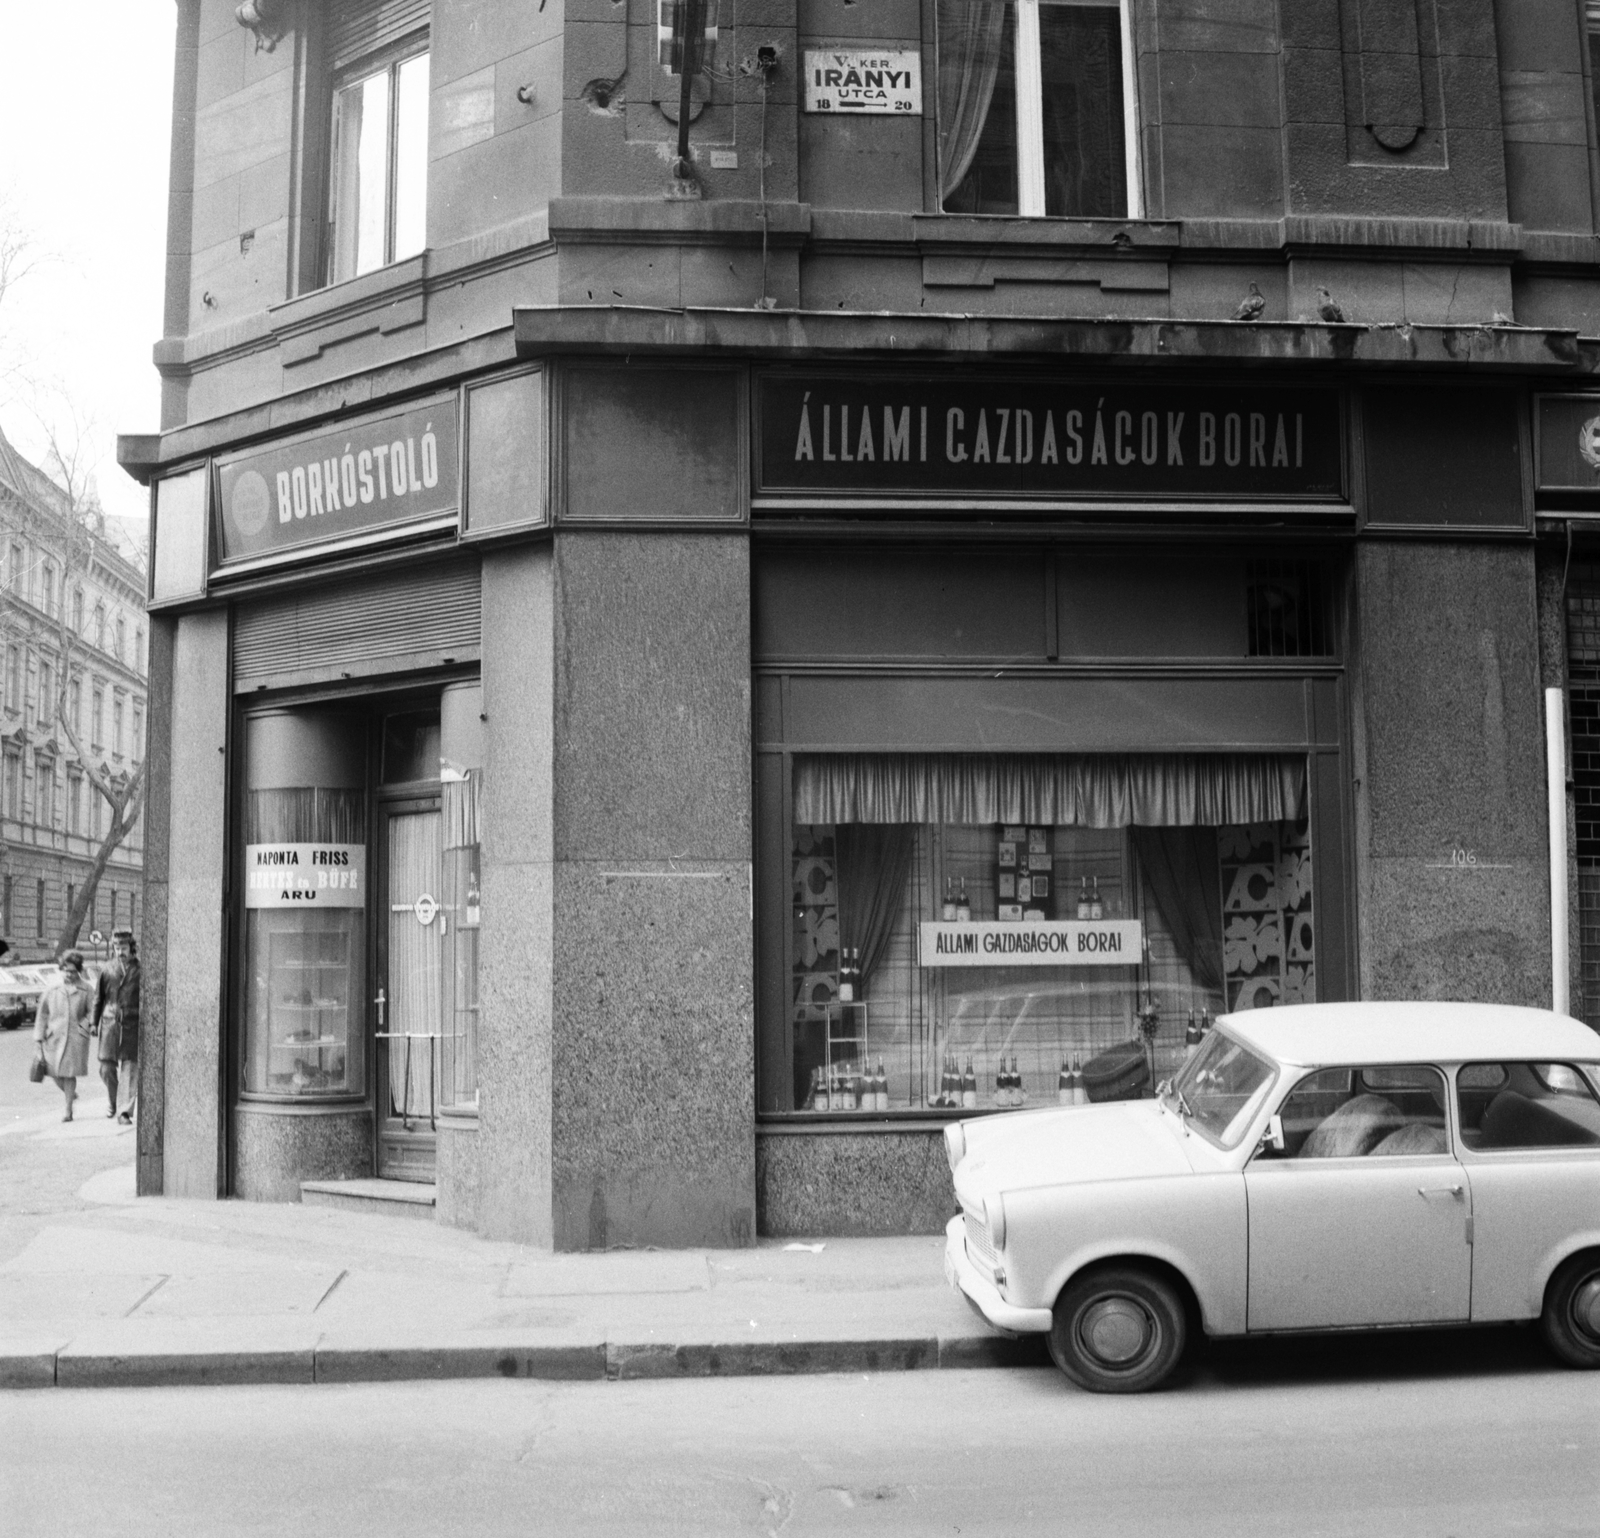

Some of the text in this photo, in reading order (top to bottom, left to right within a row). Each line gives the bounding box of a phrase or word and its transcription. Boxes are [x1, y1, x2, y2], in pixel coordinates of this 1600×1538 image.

[833, 54, 893, 69] V. KER.
[815, 66, 911, 89] IRÁNYI
[838, 89, 888, 99] UTCA
[816, 99, 913, 110] 18 20
[795, 391, 1303, 468] ÁLLAMI GAZDASÁGOK BORAI
[276, 422, 439, 524] BORKÓSTOLÓ
[257, 851, 349, 866] NAPONTA FRISS
[1452, 849, 1477, 865] 106
[317, 868, 357, 889] BÜFÉ
[983, 931, 1069, 953] GAZDASÁGOK
[1077, 931, 1122, 953] BORAI
